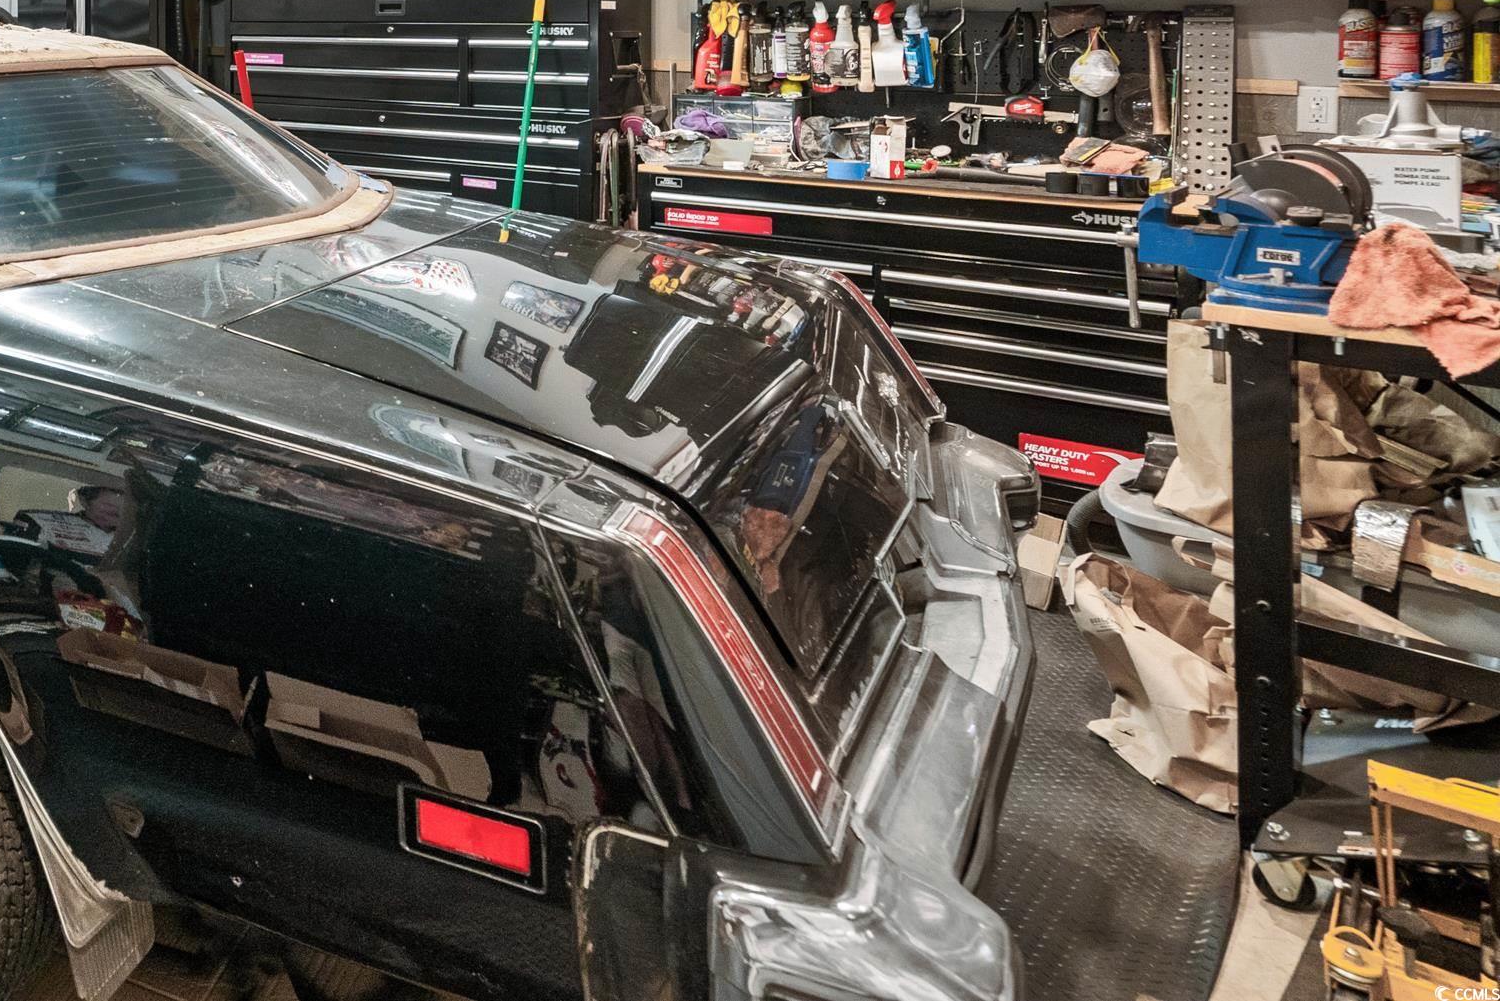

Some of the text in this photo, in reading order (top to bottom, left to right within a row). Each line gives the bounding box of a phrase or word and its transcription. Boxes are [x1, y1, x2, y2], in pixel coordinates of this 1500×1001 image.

[540, 26, 574, 36] HUSKY
[531, 123, 567, 134] HUSKY
[667, 211, 686, 219] SOLID
[1094, 213, 1138, 227] HUS
[1024, 442, 1090, 461] HEAVY DUTY
